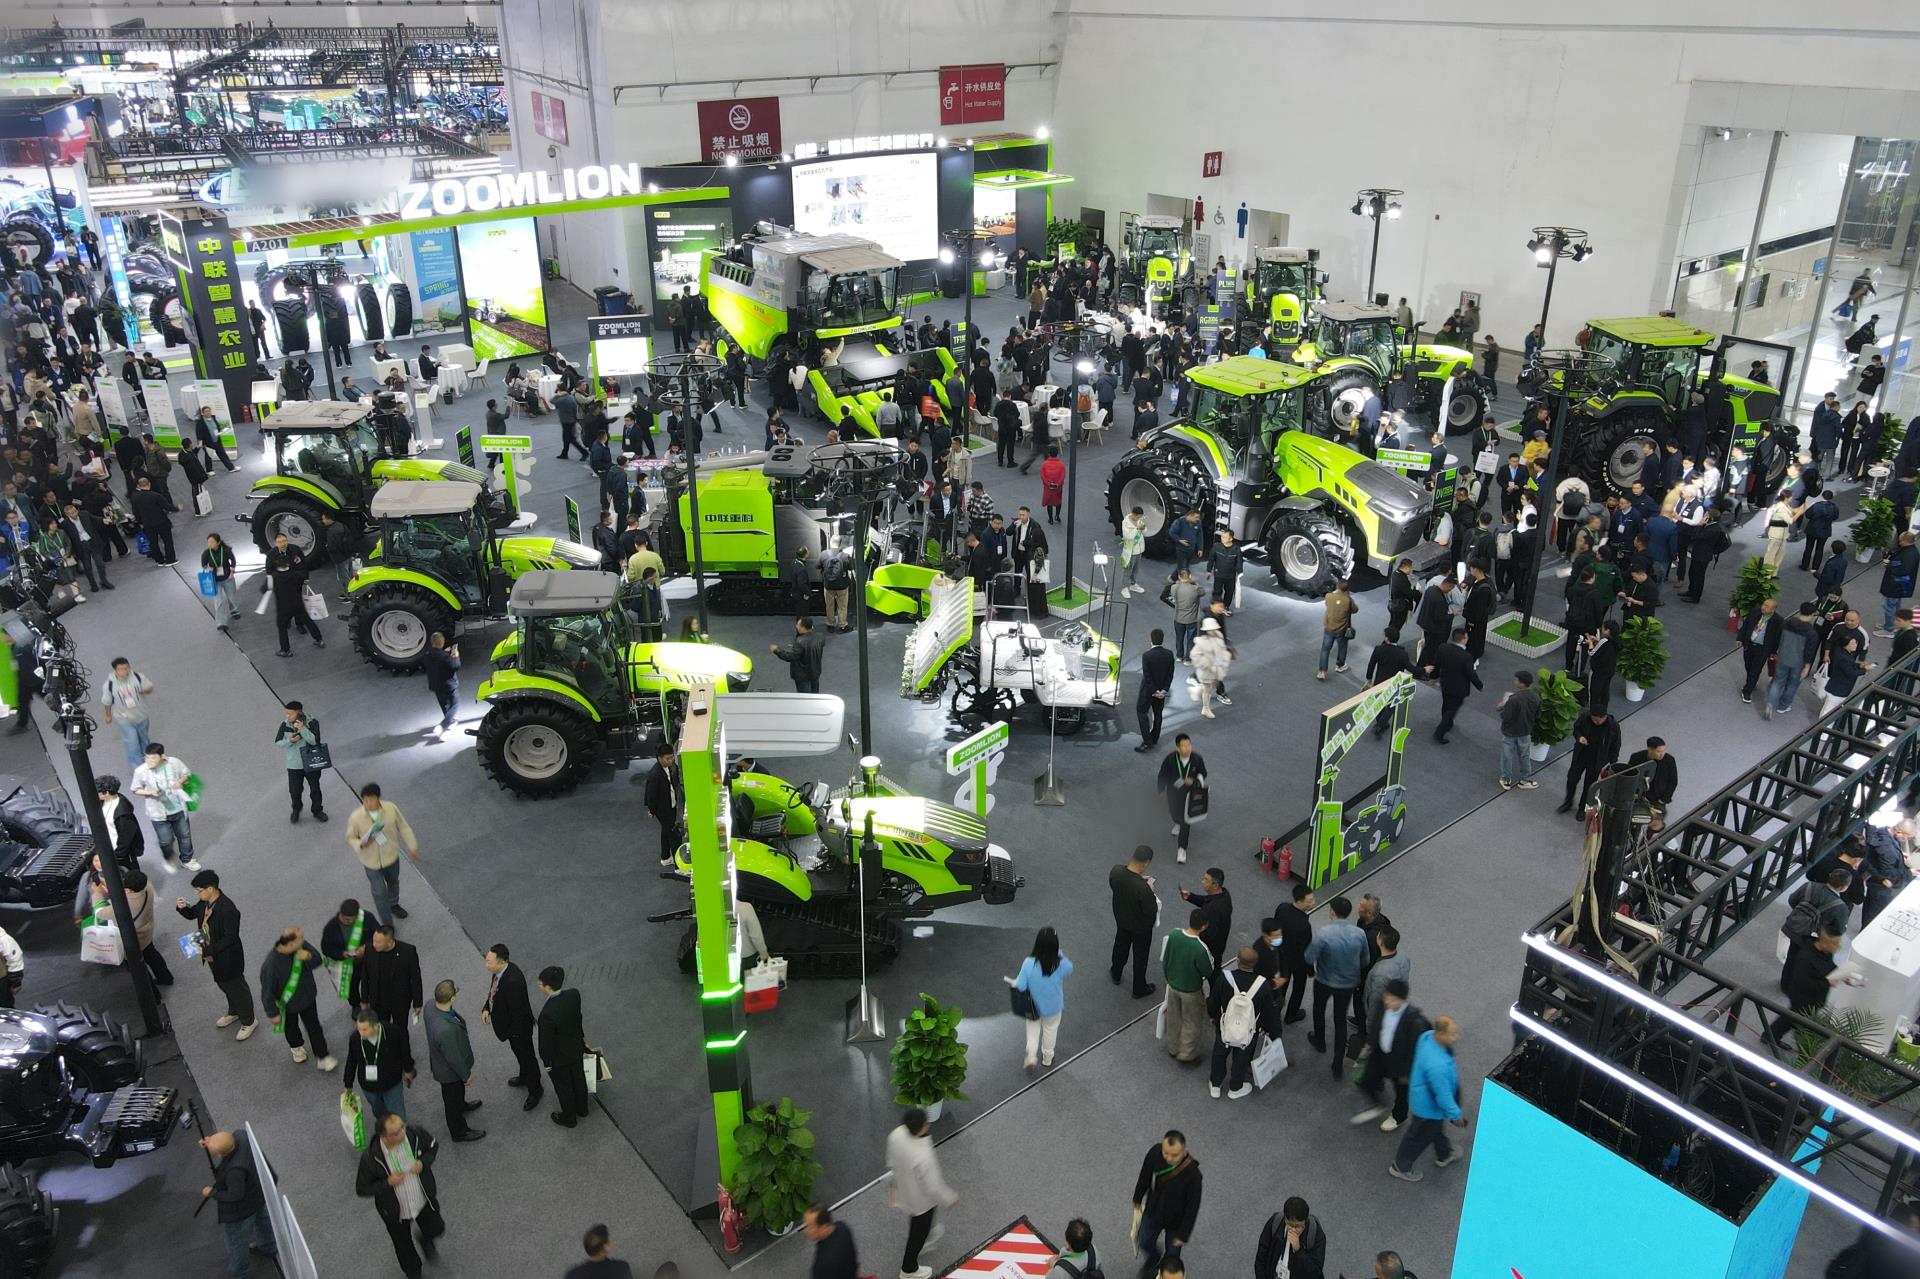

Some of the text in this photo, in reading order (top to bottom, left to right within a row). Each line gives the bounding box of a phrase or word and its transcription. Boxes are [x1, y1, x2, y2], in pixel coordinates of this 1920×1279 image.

[964, 81, 1002, 93] 开水供应处
[711, 132, 770, 151] 禁止吸烟
[711, 150, 726, 161] NO
[399, 162, 641, 221] ZOOMLION
[252, 238, 285, 252] A201
[196, 237, 248, 370] 中联智慧农业
[598, 321, 641, 330] ZOOMLION
[485, 437, 523, 445] ZOOMLION
[1382, 451, 1424, 462] ZOOMLION
[704, 513, 755, 523] 中联重科
[959, 730, 1002, 761] ZOOMLION
